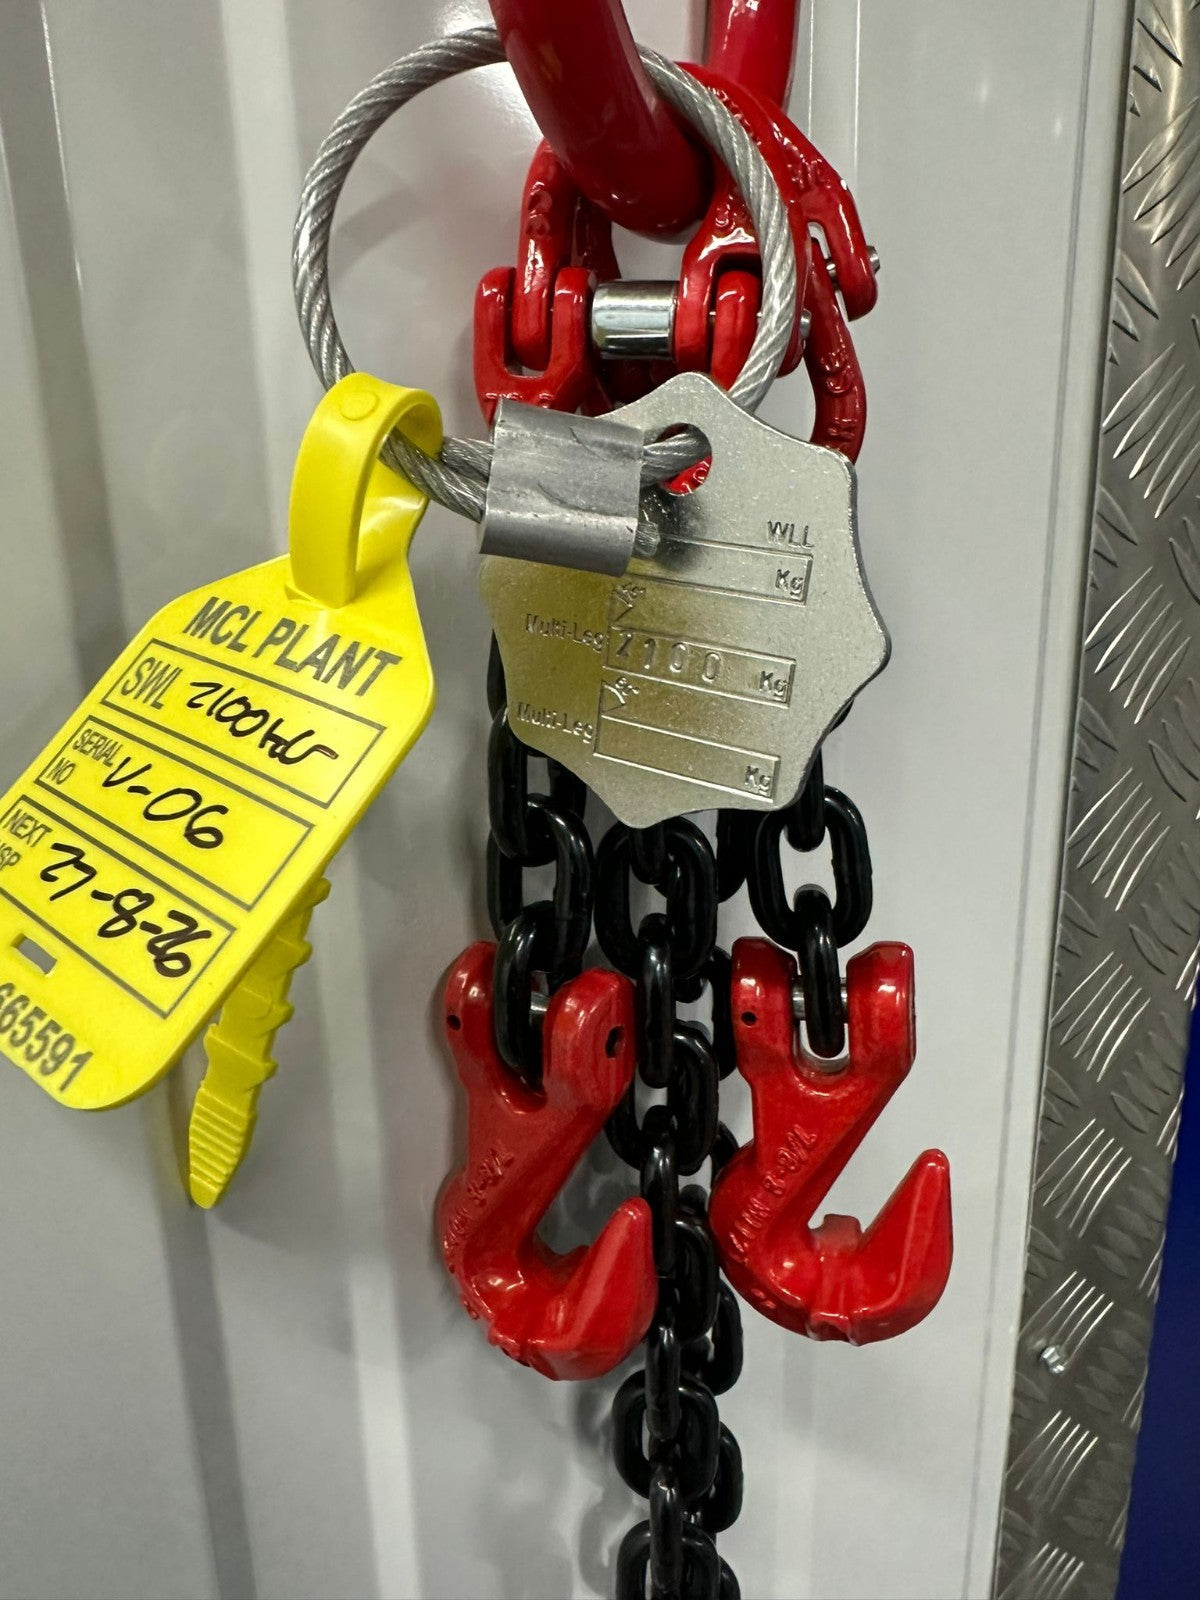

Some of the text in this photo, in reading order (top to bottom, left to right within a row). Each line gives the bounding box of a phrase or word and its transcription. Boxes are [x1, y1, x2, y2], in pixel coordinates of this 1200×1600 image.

[767, 520, 815, 548] WLL
[775, 568, 806, 600] Kg
[183, 596, 404, 697] MCL PLANT
[526, 613, 605, 653] Multi-Leg
[120, 656, 169, 710] SWL
[614, 631, 789, 700] 2100 Kg
[517, 702, 594, 744] Multi-Leg
[72, 728, 124, 769] SERIAL
[47, 757, 73, 786] NO
[744, 765, 773, 797] Kg
[102, 756, 228, 850] V-06
[2, 808, 53, 847] NEXT
[0, 838, 22, 873] SP
[40, 842, 213, 979] 27-8-26
